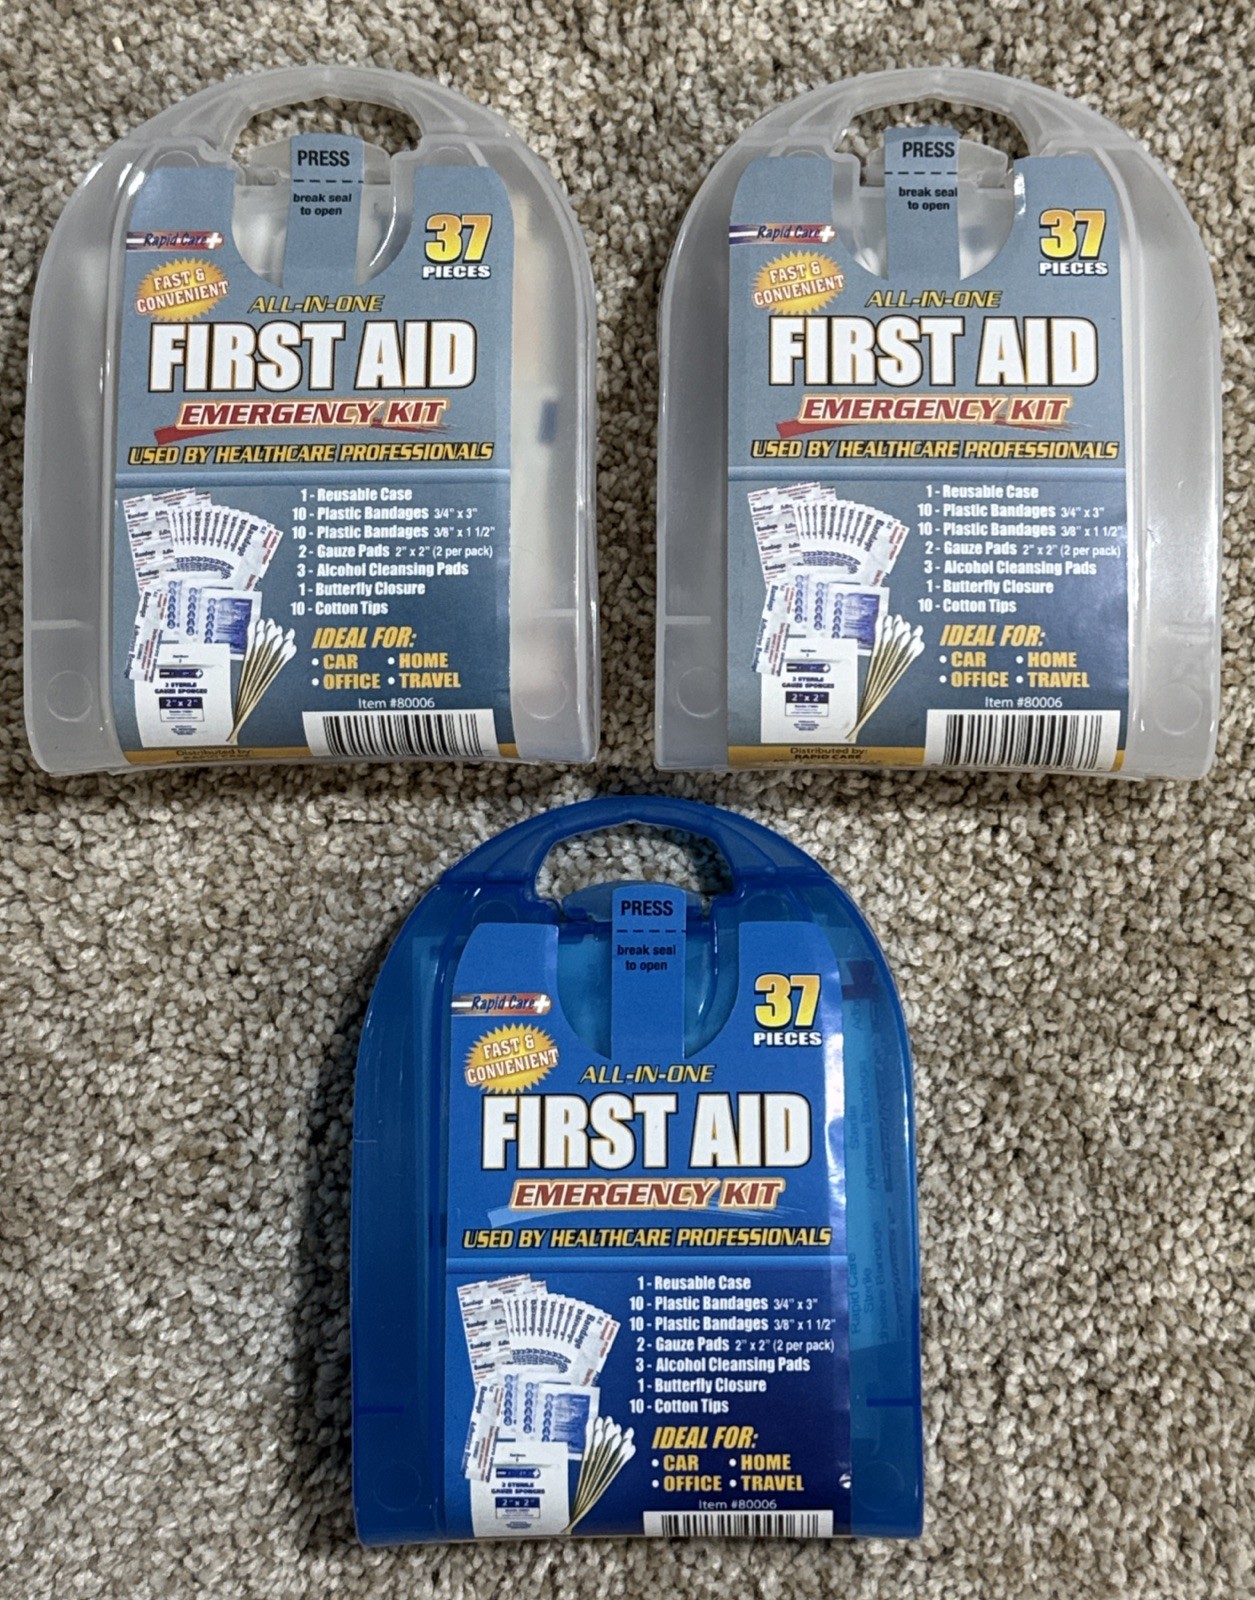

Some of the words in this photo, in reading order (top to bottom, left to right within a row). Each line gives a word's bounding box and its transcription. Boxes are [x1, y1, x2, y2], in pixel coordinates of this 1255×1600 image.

[902, 142, 955, 157] PRESS
[298, 150, 350, 166] PRESS
[293, 193, 325, 203] break
[329, 193, 352, 203] seal
[899, 187, 930, 197] break
[934, 188, 958, 197] seal
[300, 206, 311, 215] to
[314, 207, 342, 216] open
[908, 201, 918, 210] to
[922, 202, 949, 212] open
[144, 233, 179, 247] Rapid
[181, 233, 208, 245] Care
[425, 214, 492, 264] 37
[757, 225, 791, 241] Rapid
[795, 226, 820, 239] Care
[1038, 209, 1106, 259] 37
[422, 265, 491, 279] PIECES
[769, 264, 806, 283] FAST
[811, 261, 821, 276] &
[1039, 261, 1108, 276] PIECES
[153, 270, 187, 291] FAST
[194, 268, 205, 281] &
[136, 281, 229, 313] CONVENIENT
[754, 275, 845, 306] CONVENIENT
[248, 295, 384, 313] ALL-IN-ONE
[865, 290, 1002, 308] ALL-IN-ONE
[149, 321, 345, 392] FIRST
[355, 319, 476, 392] AID
[769, 316, 965, 386] FIRST
[976, 316, 1099, 386] AID
[176, 401, 380, 428] EMERGENCY
[383, 399, 448, 426] KIT
[800, 396, 1004, 423] EMERGENCY
[1007, 394, 1072, 422] KIT
[129, 446, 180, 464] USED
[183, 446, 211, 464] BY
[214, 444, 336, 463] HEALTHCARE
[339, 443, 494, 461] PROFESSIONALS
[751, 440, 802, 459] USED
[806, 440, 834, 459] BY
[837, 440, 960, 458] HEALTHCARE
[963, 440, 1119, 459] PROFESSIONALS
[318, 488, 377, 502] Reusable
[381, 488, 412, 501] Case
[943, 485, 1004, 499] Reusable
[1007, 485, 1039, 499] Case
[318, 506, 361, 521] Plastic
[364, 506, 428, 521] Bandages
[943, 504, 987, 518] Plastic
[991, 504, 1056, 519] Bandages
[318, 525, 361, 540] Plastic
[364, 525, 428, 540] Bandages
[943, 522, 987, 537] Plastic
[991, 522, 1056, 538] Bandages
[318, 544, 355, 558] Gauze
[358, 544, 390, 558] Pads
[432, 546, 442, 559] (2
[444, 549, 462, 559] per
[465, 545, 493, 559] pack)
[944, 542, 982, 555] Gauze
[985, 541, 1017, 555] Pads
[1060, 544, 1070, 557] (2
[1073, 547, 1090, 558] per
[1092, 545, 1121, 558] pack)
[317, 562, 365, 577] Alcohol
[368, 562, 434, 577] Cleansing
[437, 562, 469, 575] Pads
[944, 561, 993, 575] Alcohol
[996, 561, 1062, 577] Cleansing
[1065, 561, 1097, 575] Pads
[316, 582, 372, 597] Butterfly
[375, 582, 425, 595] Closure
[943, 580, 1000, 595] Butterfly
[1003, 580, 1054, 594] Closure
[315, 602, 360, 615] Cotton
[362, 601, 389, 617] Tips
[943, 599, 988, 612] Cotton
[991, 599, 1017, 614] Tips
[312, 627, 368, 648] IDEAL
[372, 627, 417, 647] FOR:
[940, 625, 996, 646] IDEAL
[1001, 625, 1045, 646] FOR:
[323, 654, 358, 669] CAR
[399, 653, 448, 668] HOME
[951, 652, 986, 667] CAR
[1028, 652, 1077, 667] HOME
[323, 674, 381, 689] OFFICE
[399, 673, 461, 688] TRAVEL
[951, 672, 1009, 687] OFFICE
[1028, 672, 1090, 687] TRAVEL
[358, 698, 387, 710] Item
[389, 697, 435, 709] #80006
[985, 697, 1014, 708] Item
[1017, 696, 1062, 708] #80006
[621, 901, 673, 916] PRESS
[617, 945, 649, 955] break
[653, 945, 676, 955] seal
[626, 960, 636, 970] to
[640, 961, 668, 971] open
[472, 996, 505, 1011] Rapid
[509, 997, 535, 1009] Care
[754, 974, 821, 1029] 37
[483, 1039, 520, 1059] FAST
[524, 1034, 534, 1048] &
[753, 1032, 822, 1046] PIECES
[465, 1047, 559, 1085] CONVENIENT
[580, 1064, 716, 1084] ALL-IN-ONE
[481, 1093, 678, 1170] FIRST
[689, 1092, 812, 1168] AID
[510, 1179, 719, 1209] EMERGENCY
[720, 1178, 785, 1209] KIT
[463, 1230, 514, 1249] USED
[518, 1229, 547, 1248] BY
[550, 1228, 671, 1247] HEALTHCARE
[676, 1226, 832, 1246] PROFESSIONALS
[655, 1276, 715, 1290] Reusable
[719, 1276, 751, 1290] Case
[655, 1296, 699, 1312] Plastic
[703, 1297, 769, 1313] Bandages
[655, 1317, 699, 1332] Plastic
[703, 1317, 769, 1333] Bandages
[656, 1338, 694, 1352] Gauze
[697, 1337, 729, 1351] Pads
[773, 1339, 783, 1353] (2
[786, 1342, 803, 1353] per
[806, 1339, 834, 1353] pack)
[656, 1358, 705, 1373] Alcohol
[708, 1357, 775, 1373] Cleansing
[778, 1357, 810, 1371] Pads
[655, 1378, 711, 1394] Butterfly
[715, 1378, 767, 1392] Closure
[654, 1399, 698, 1413] Cotton
[702, 1399, 729, 1415] Tips
[652, 1427, 710, 1449] IDEAL
[714, 1426, 759, 1449] FOR:
[663, 1455, 699, 1471] CAR
[741, 1455, 791, 1470] HOME
[663, 1476, 722, 1491] OFFICE
[741, 1476, 804, 1491] TRAVEL
[700, 1499, 728, 1510] Item
[731, 1499, 777, 1510] #80006
